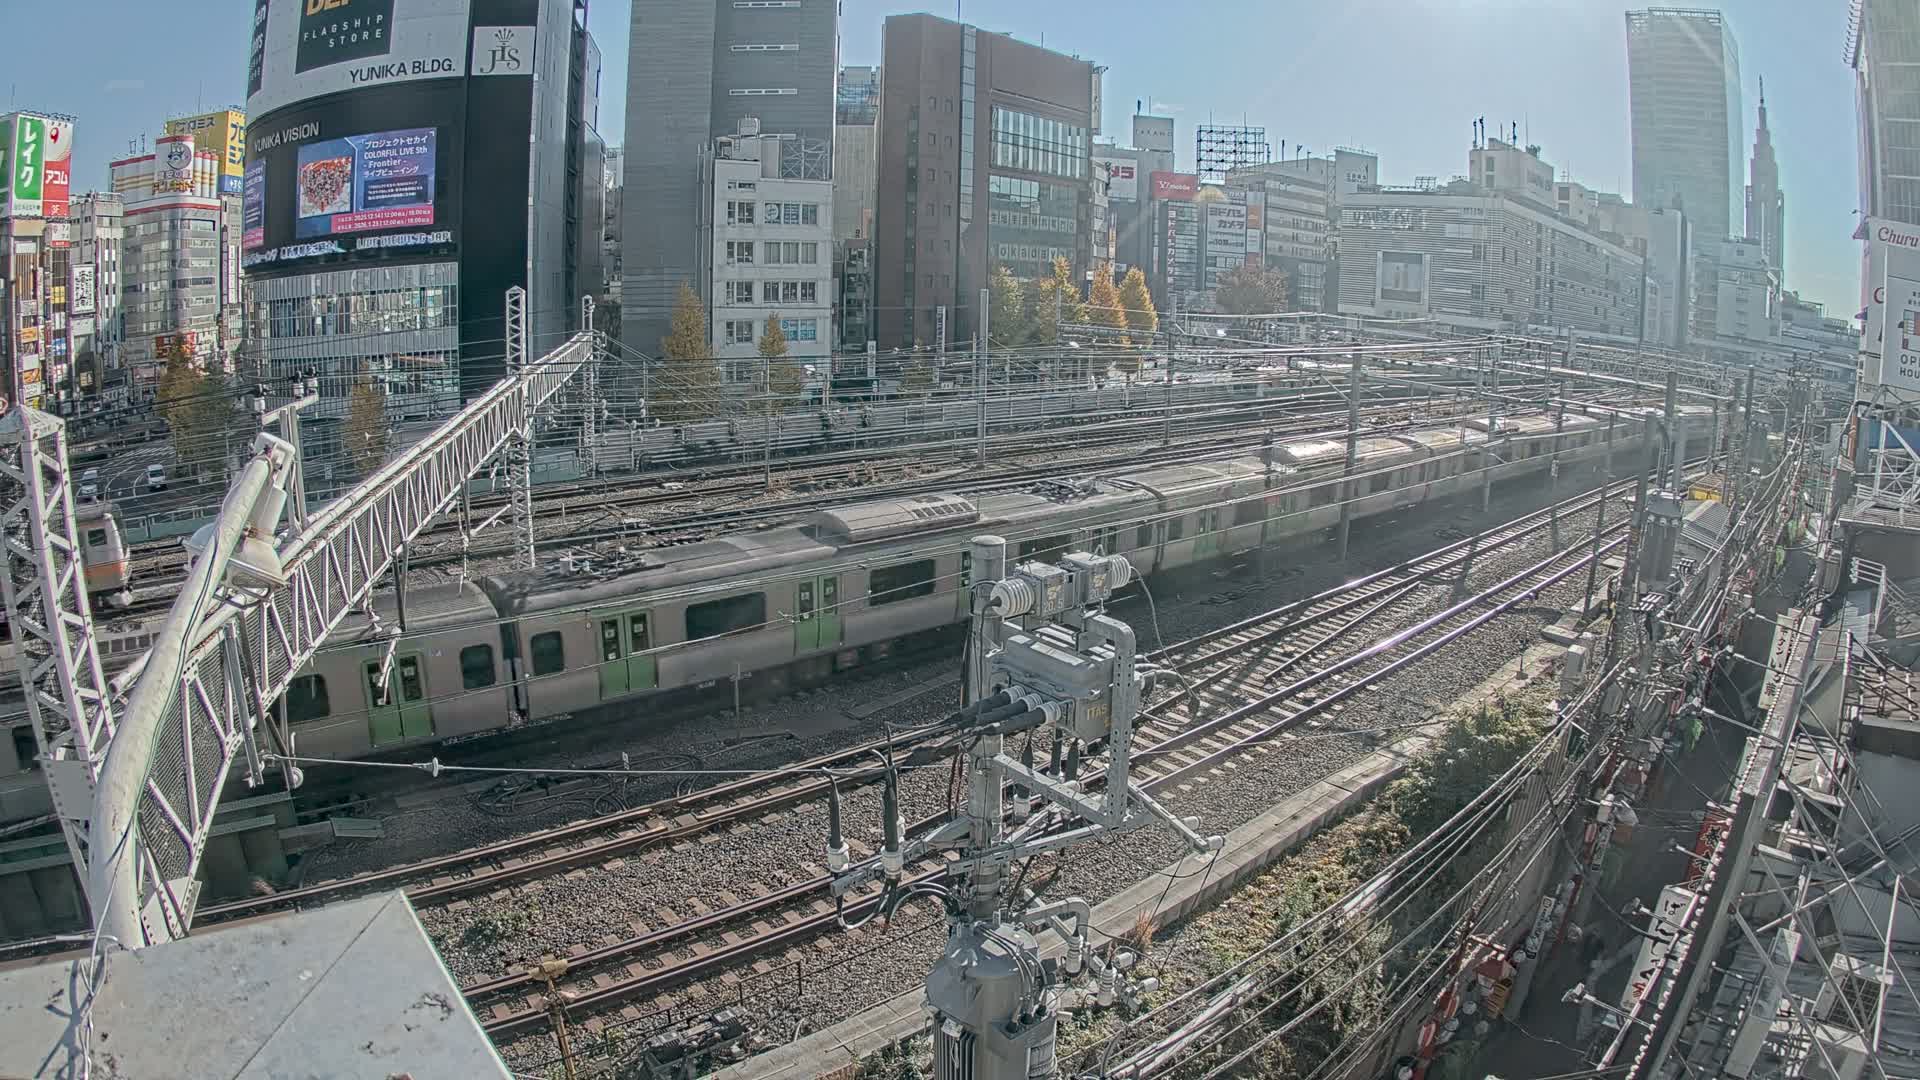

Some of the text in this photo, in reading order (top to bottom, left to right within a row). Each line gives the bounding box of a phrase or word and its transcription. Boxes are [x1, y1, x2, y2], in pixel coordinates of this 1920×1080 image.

[304, 14, 383, 41] FLAGSHIP
[328, 29, 382, 48] STORE
[350, 59, 456, 83] YUNIKA BLDG.
[254, 121, 319, 153] YUNIKA VISION
[21, 121, 37, 188] レイク
[45, 169, 69, 185] アコム
